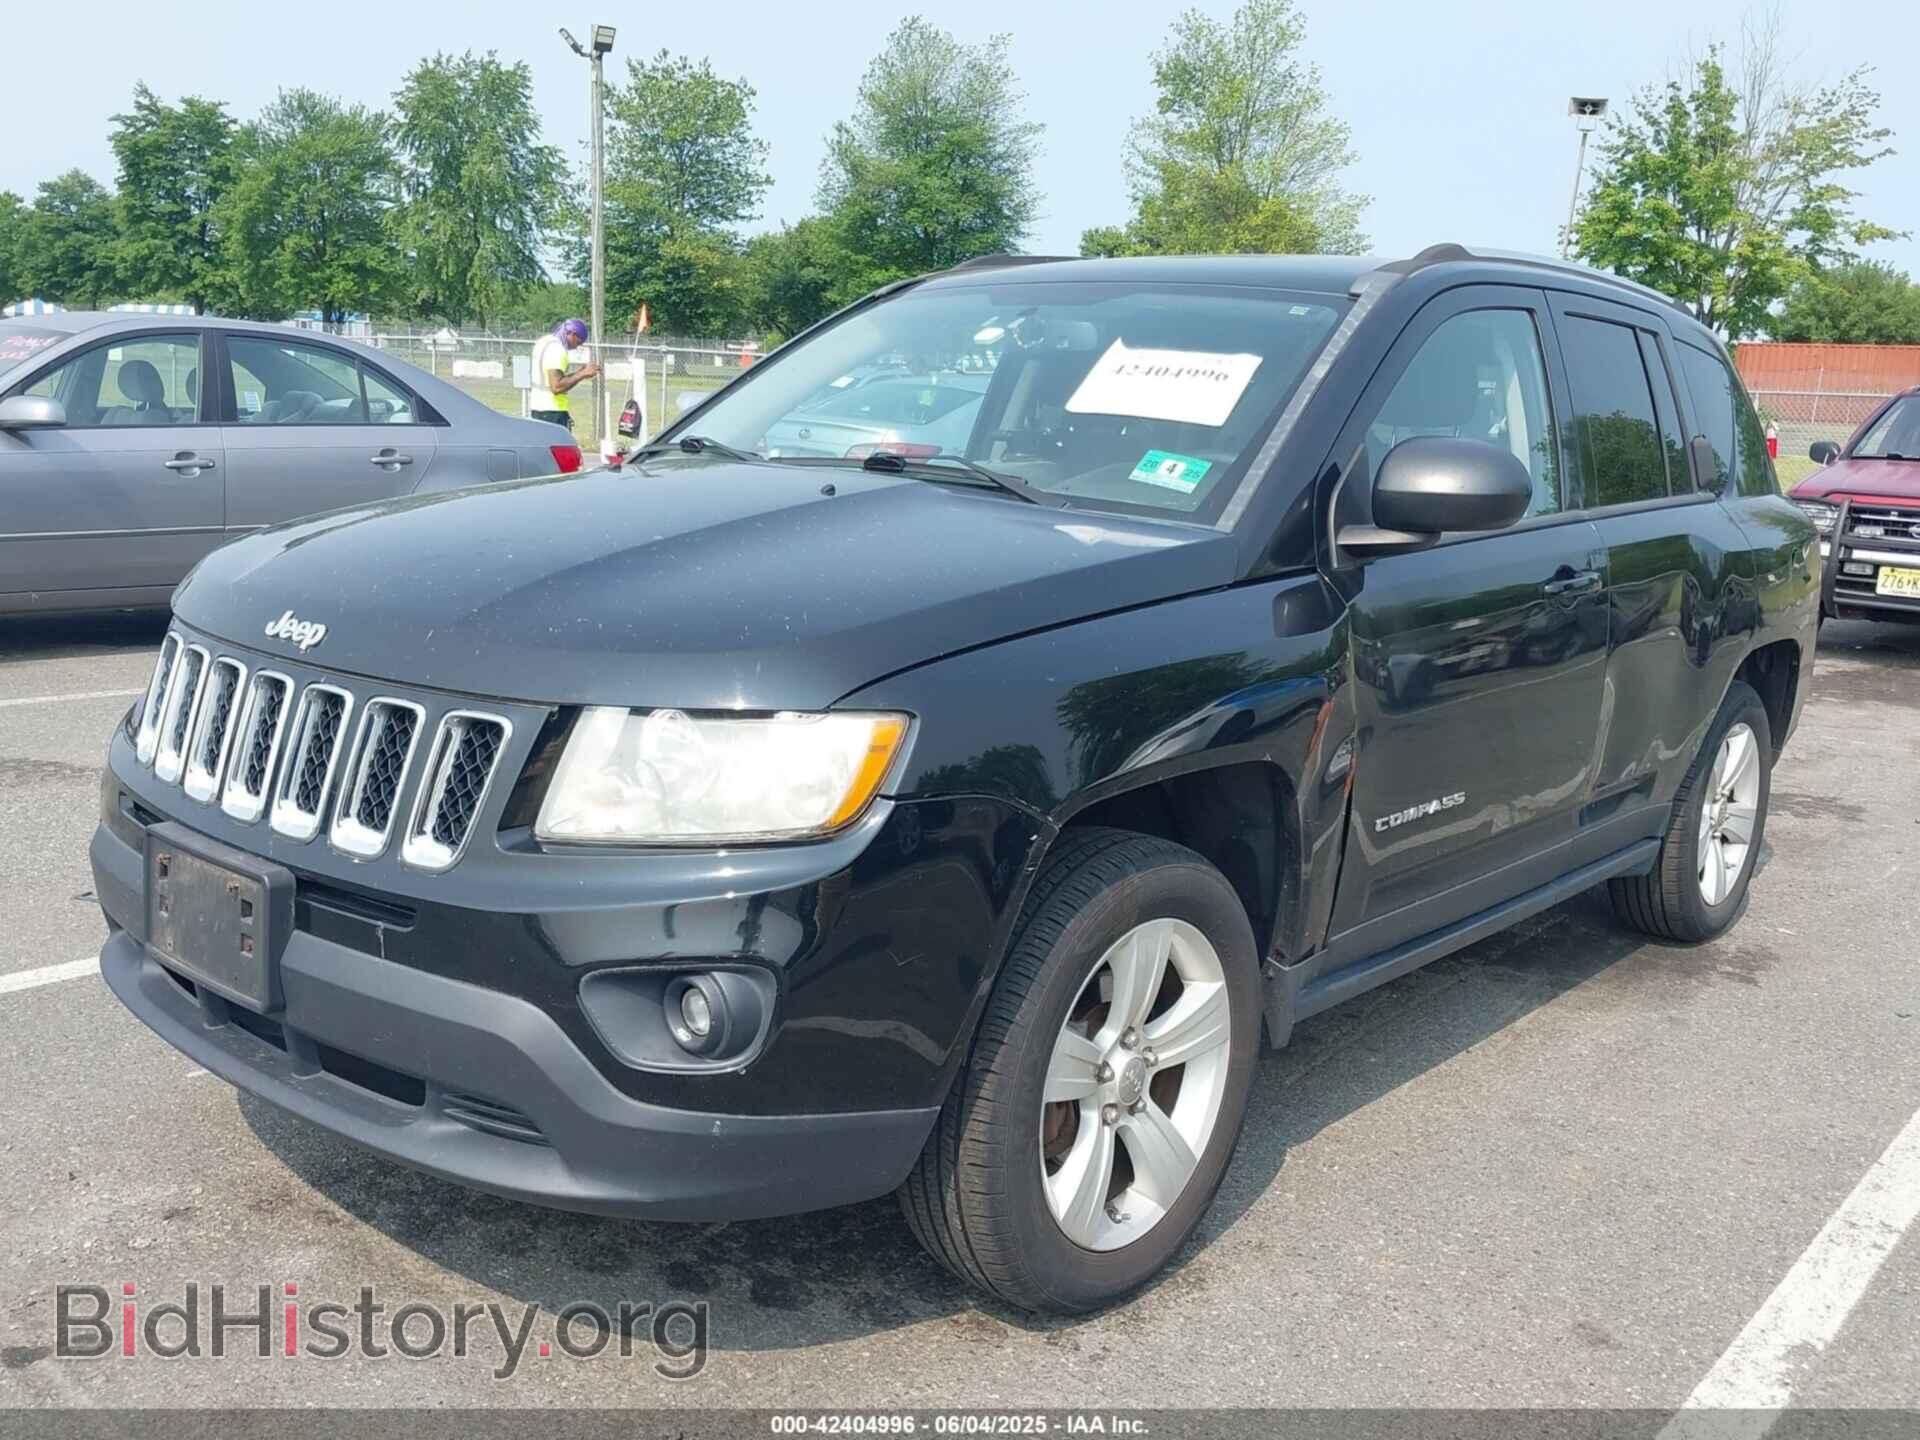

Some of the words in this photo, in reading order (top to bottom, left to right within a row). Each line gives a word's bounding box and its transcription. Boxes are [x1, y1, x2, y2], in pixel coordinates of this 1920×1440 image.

[1166, 463, 1178, 474] 4
[265, 610, 326, 650] Jeep
[1375, 792, 1466, 833] COMPASS
